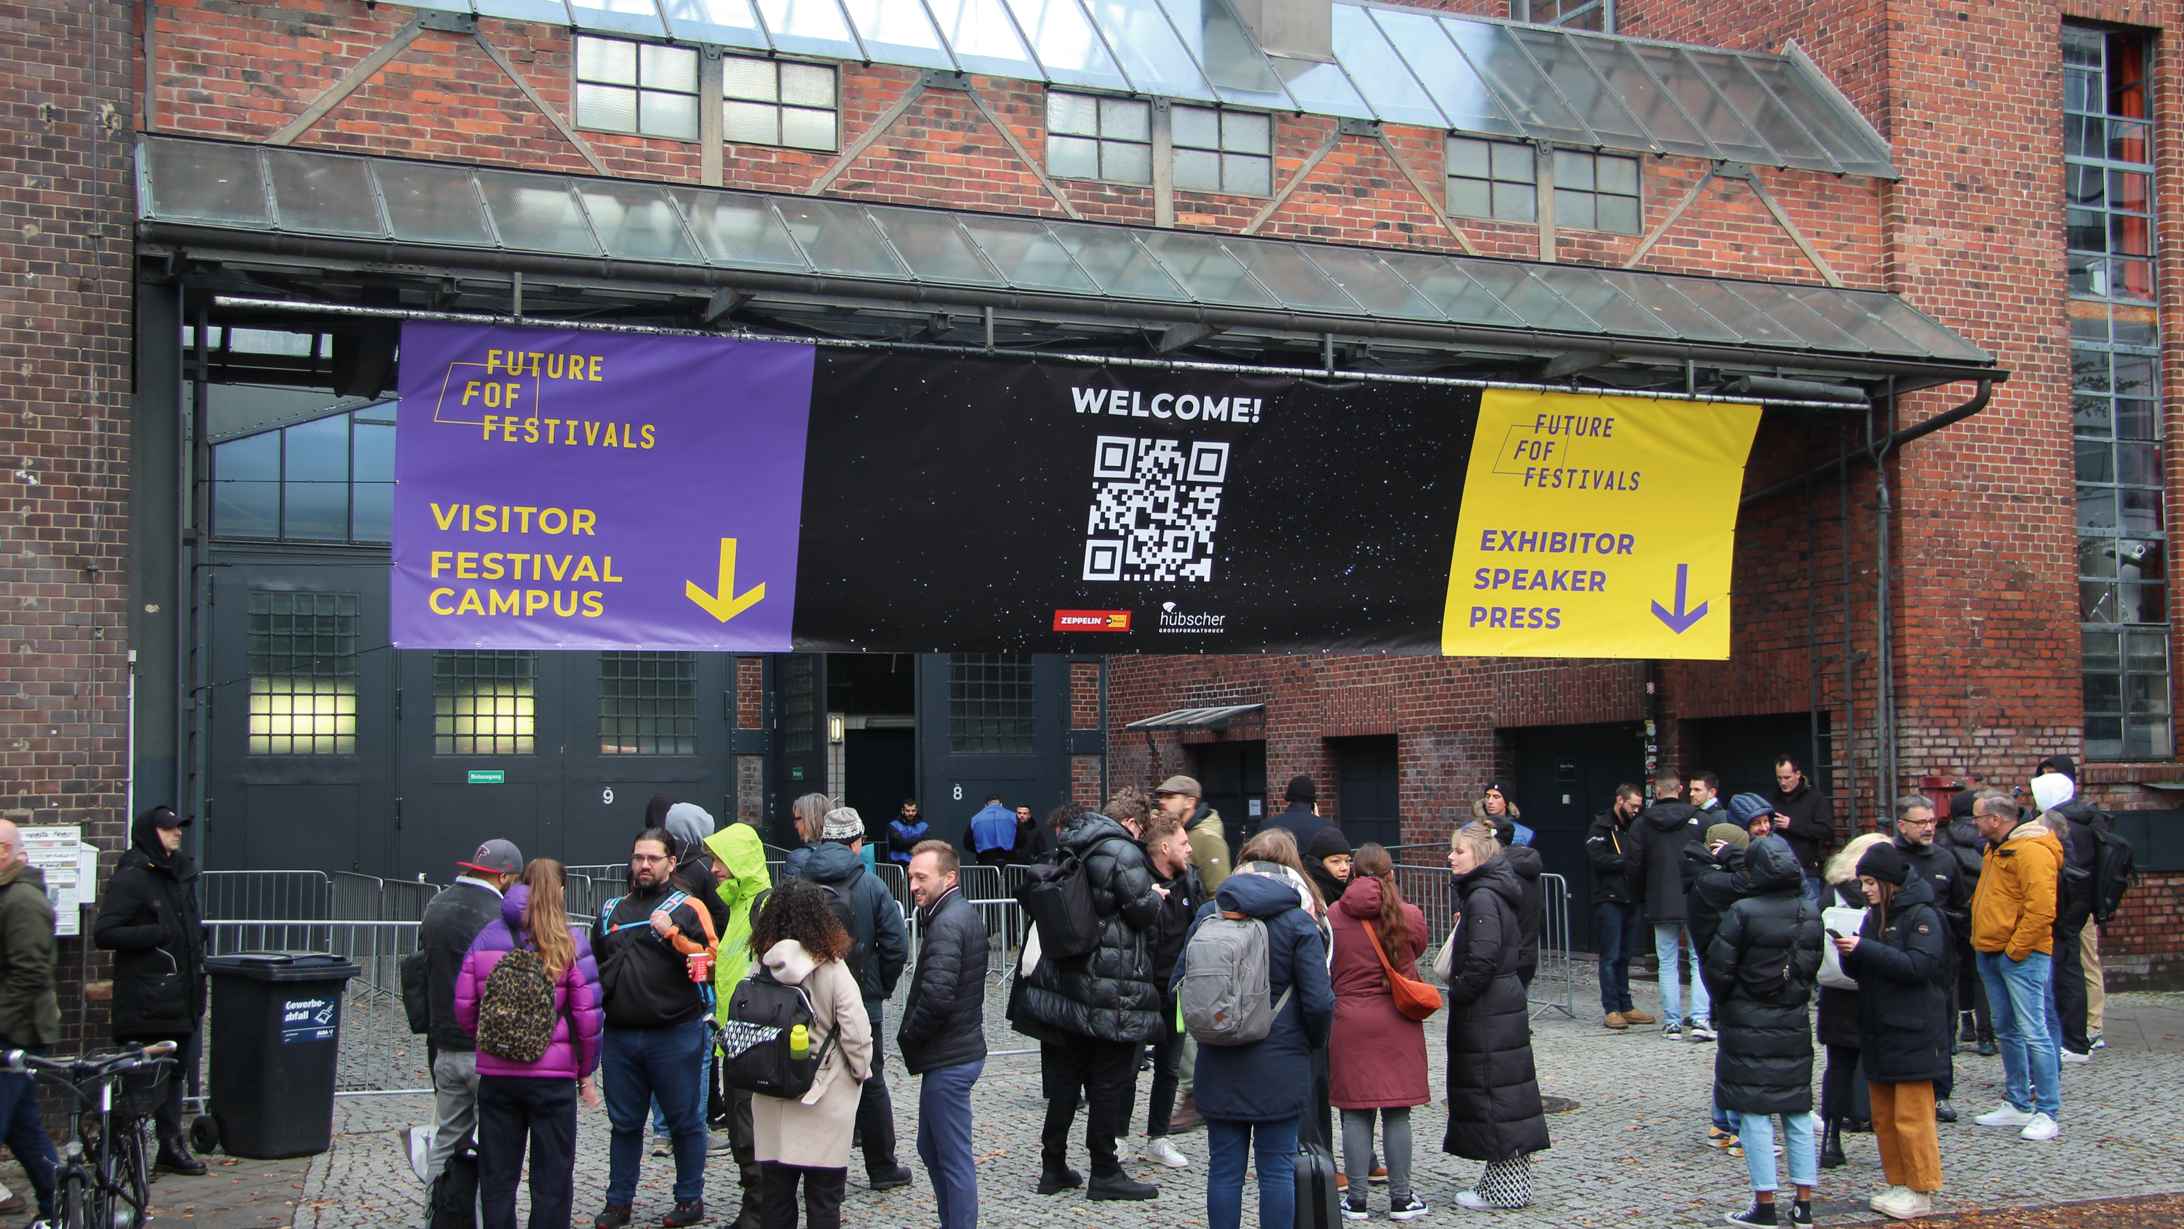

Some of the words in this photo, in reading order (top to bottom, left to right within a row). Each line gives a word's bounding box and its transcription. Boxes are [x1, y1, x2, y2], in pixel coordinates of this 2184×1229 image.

[487, 349, 604, 381] FUTURE
[462, 381, 521, 409] FOF
[1072, 387, 1262, 424] WELCOME!
[483, 415, 656, 449] FESTIVALS
[1534, 414, 1615, 438] FUTURE
[1513, 440, 1555, 461] FOF
[1524, 467, 1641, 491] FESTIVALS
[430, 503, 597, 535] VISITOR
[1480, 529, 1635, 555] EXHIBITOR
[431, 551, 623, 583] FESTIVAL
[1473, 567, 1607, 592] SPEAKER
[428, 588, 604, 618] CAMPUS
[1060, 616, 1102, 624] ZEPPELIN
[1160, 611, 1226, 626] hübscher
[1469, 606, 1562, 629] PRESS
[603, 789, 614, 804] 9
[953, 786, 962, 800] 8
